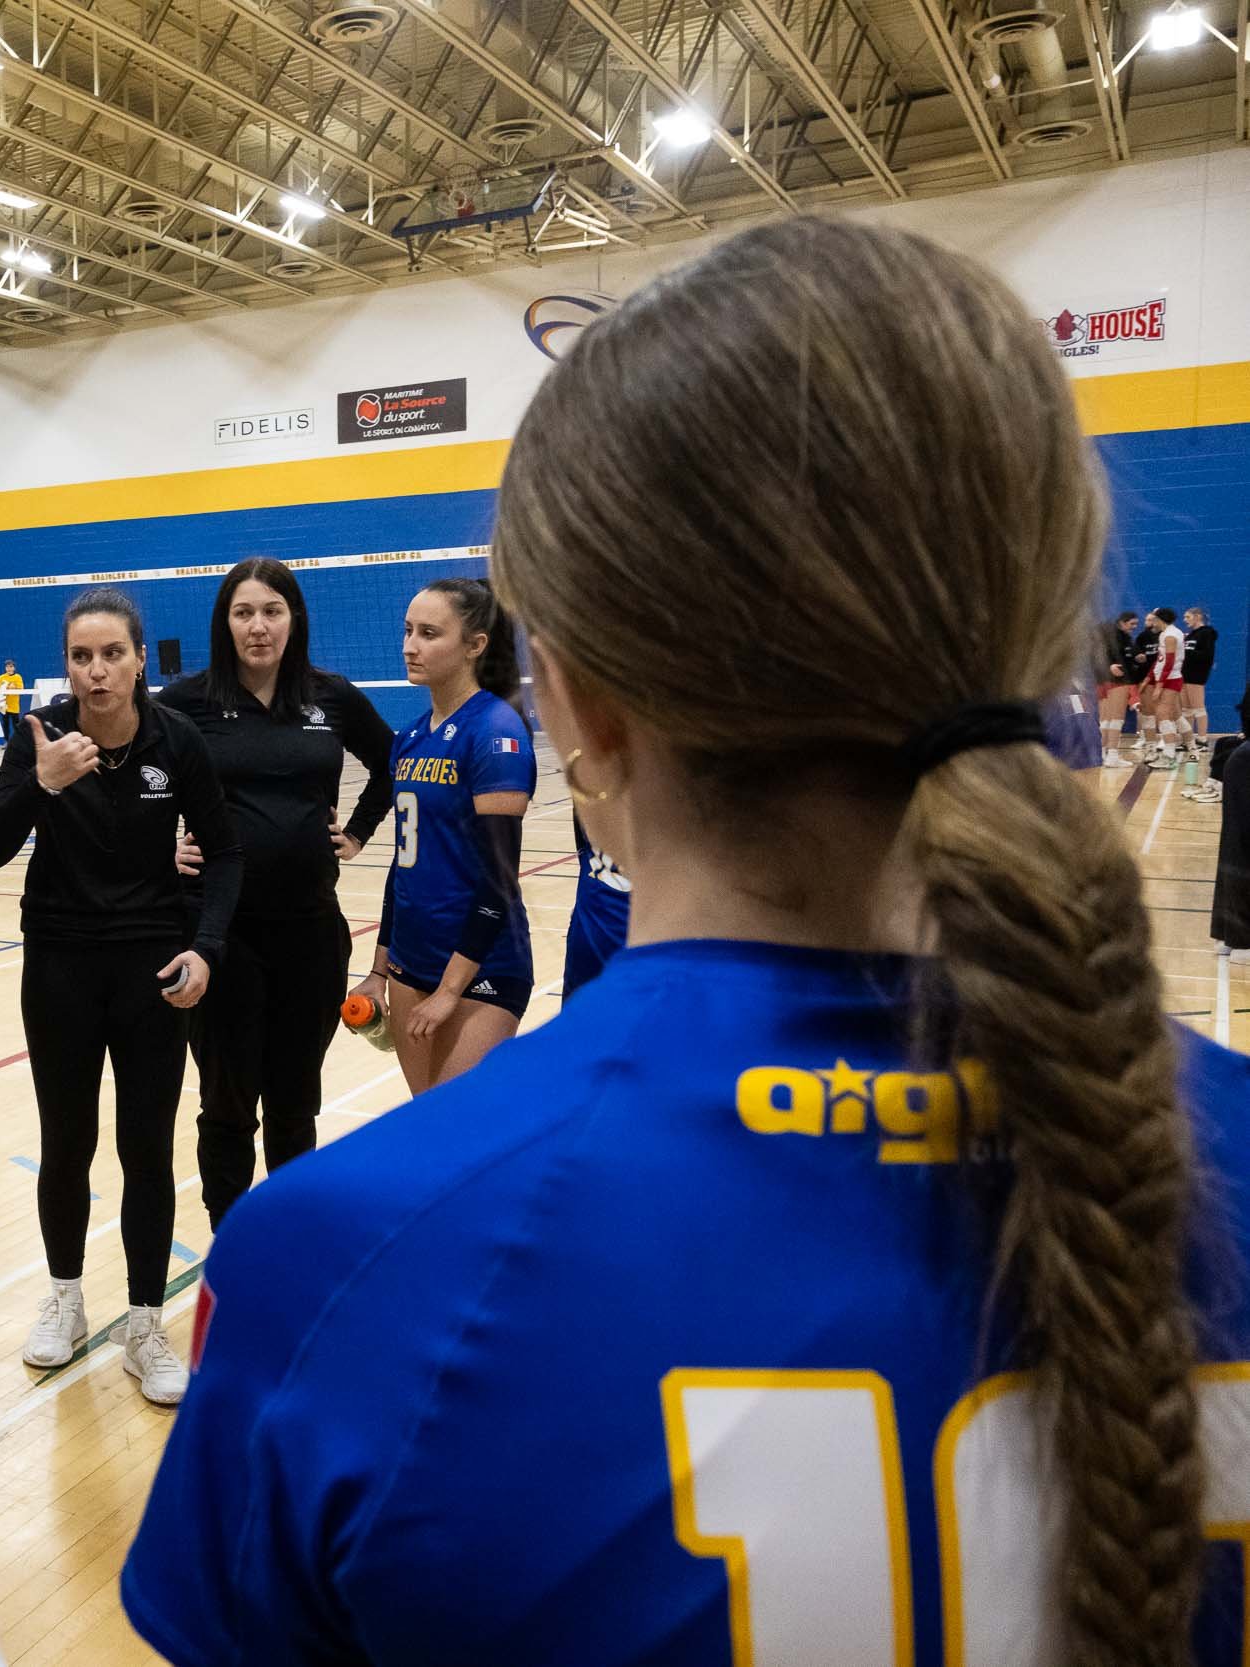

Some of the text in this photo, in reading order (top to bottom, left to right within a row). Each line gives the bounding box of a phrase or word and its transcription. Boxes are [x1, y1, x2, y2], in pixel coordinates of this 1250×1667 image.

[1087, 299, 1165, 342] HOUSE
[383, 388, 424, 400] MARITIME
[384, 396, 447, 411] La Source
[218, 413, 310, 439] FIDELIS
[383, 408, 426, 424] du sport
[411, 757, 458, 785] BLEUES
[396, 791, 419, 869] 3
